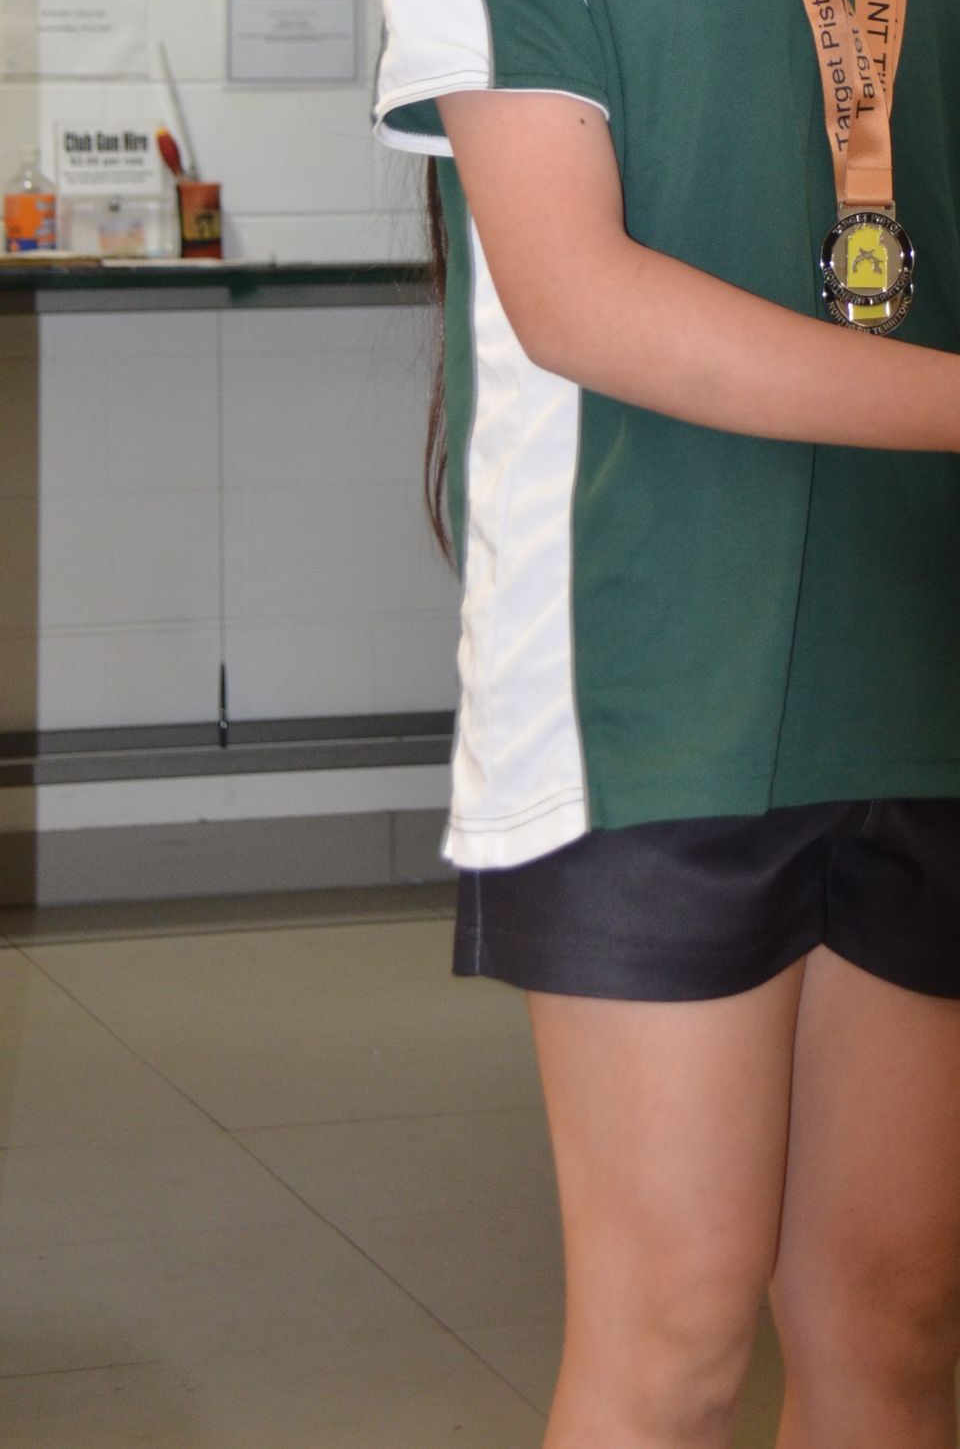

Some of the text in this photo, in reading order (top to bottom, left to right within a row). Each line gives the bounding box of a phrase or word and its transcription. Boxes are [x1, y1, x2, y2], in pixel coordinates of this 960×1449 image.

[866, 1, 890, 45] NT
[827, 57, 853, 151] Target
[65, 131, 91, 151] Club
[124, 130, 148, 151] Hire
[832, 214, 867, 234] TARGET
[872, 296, 912, 334] TERRITORY
